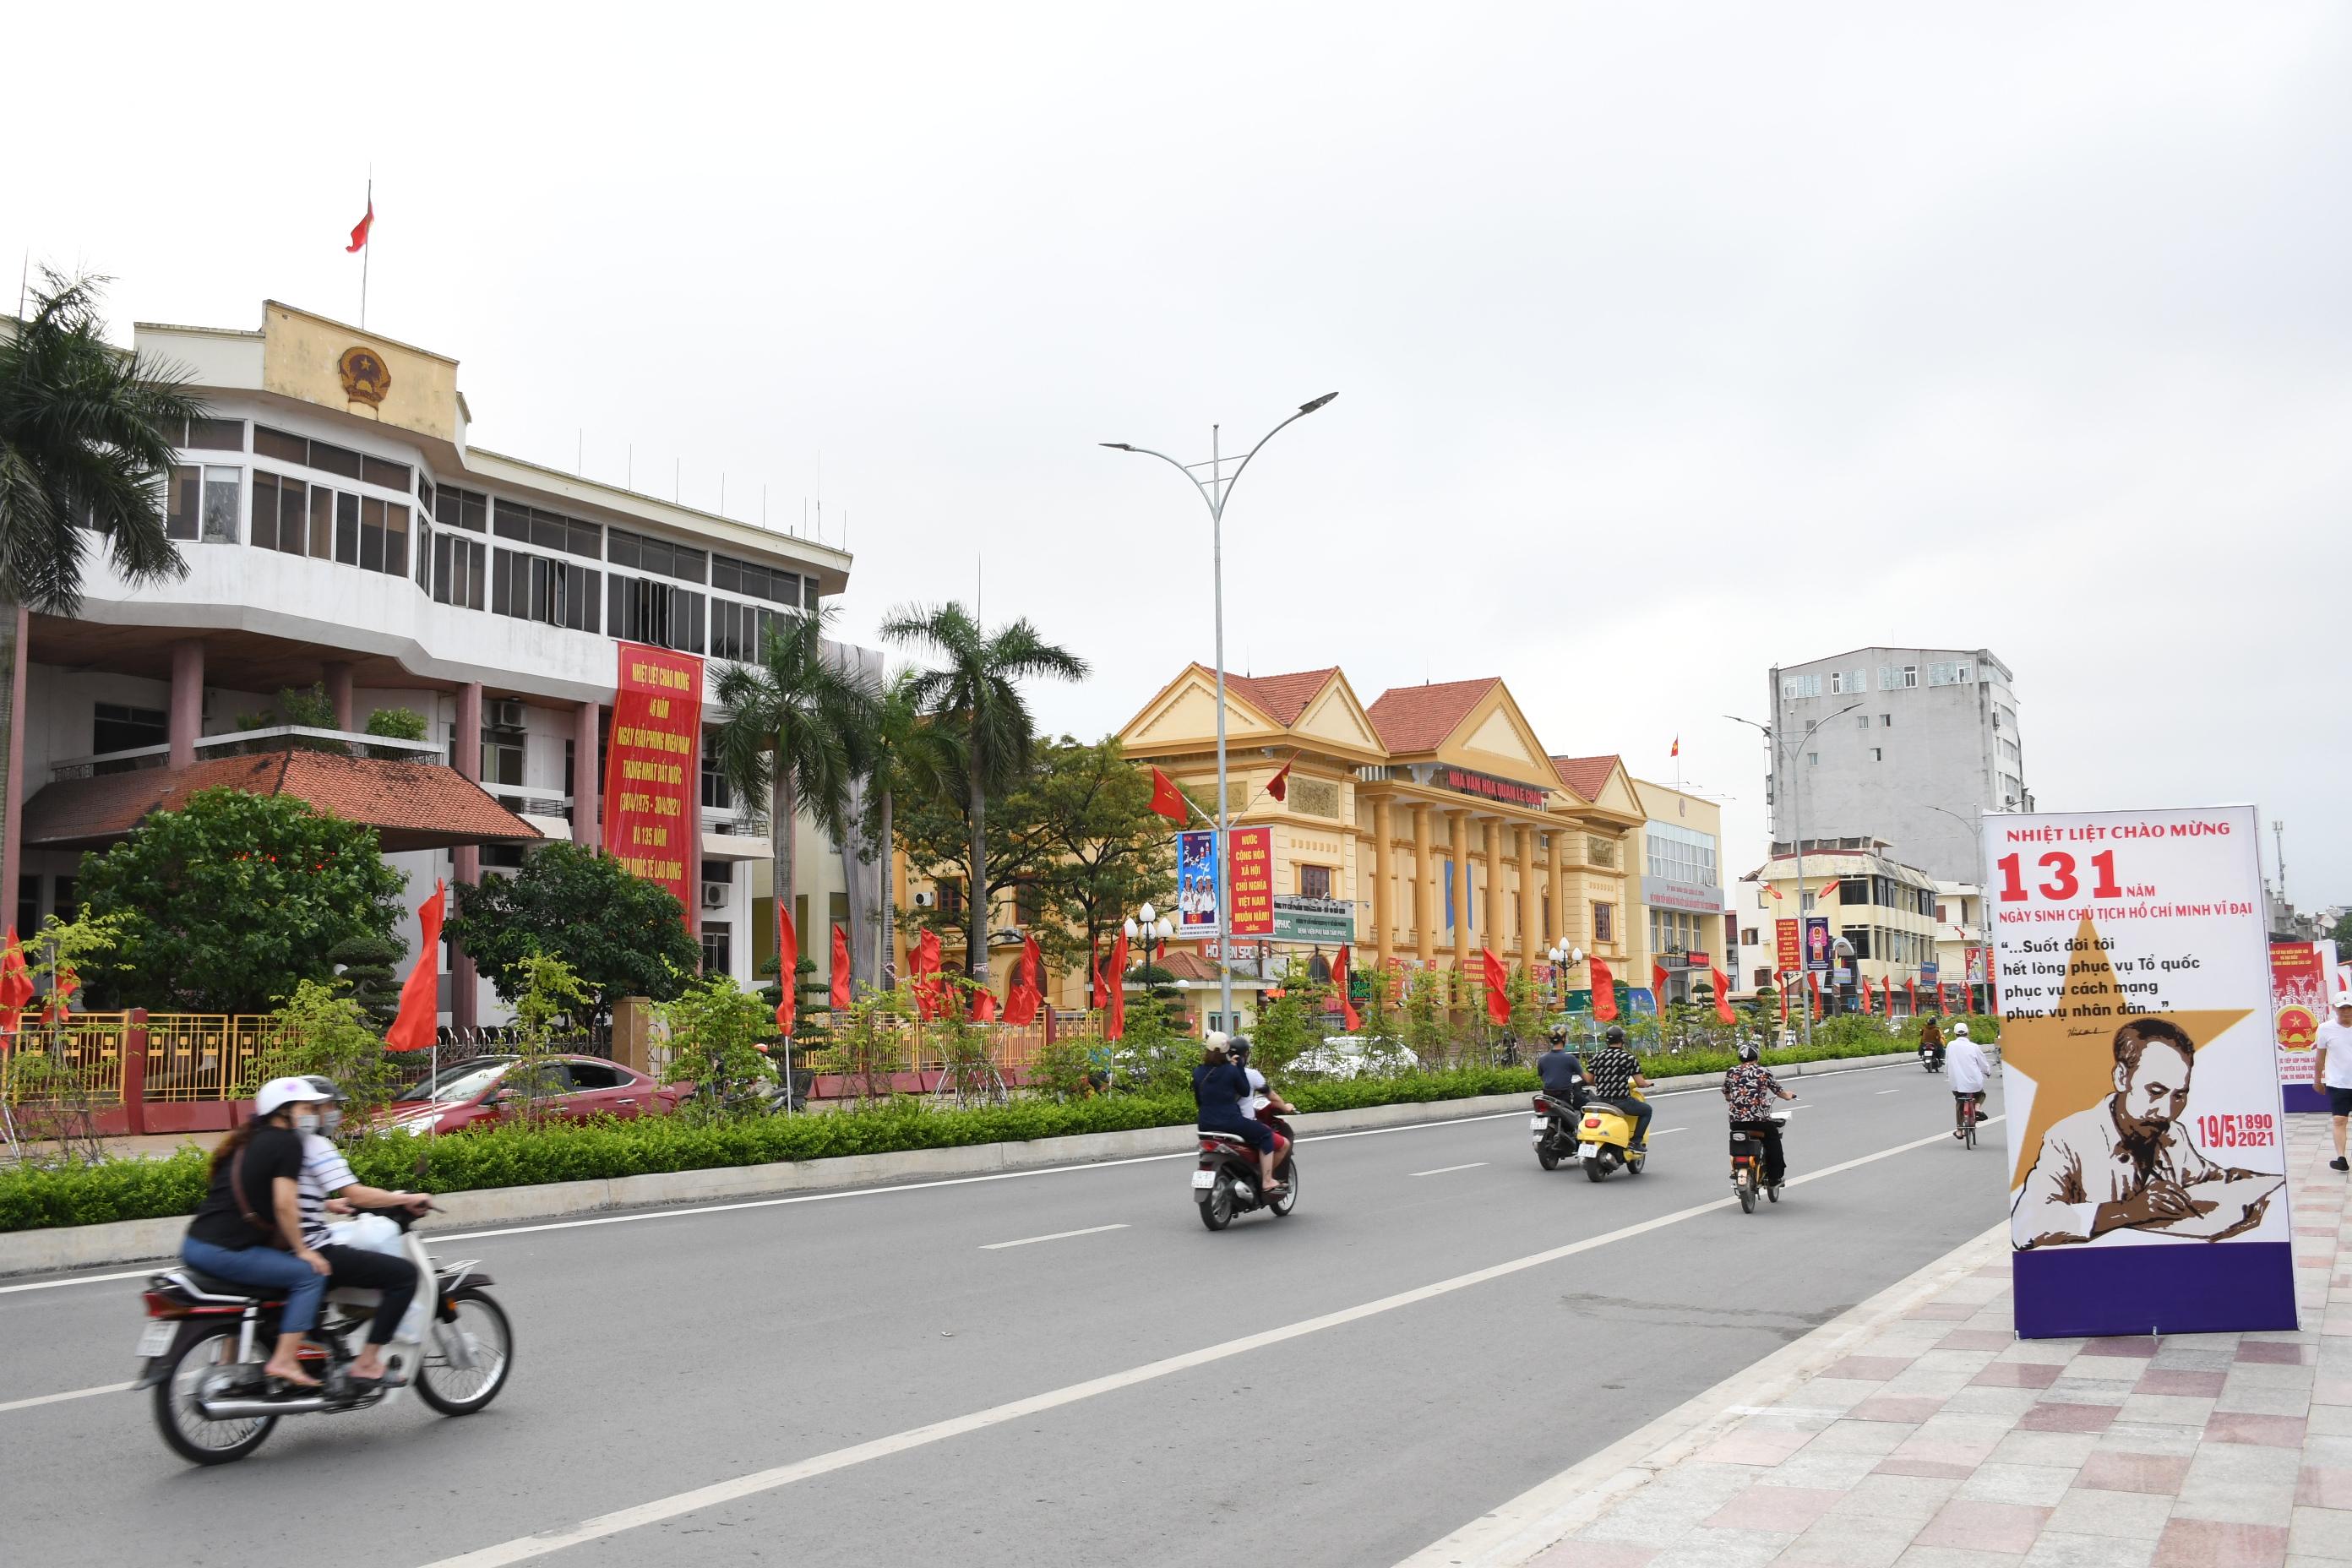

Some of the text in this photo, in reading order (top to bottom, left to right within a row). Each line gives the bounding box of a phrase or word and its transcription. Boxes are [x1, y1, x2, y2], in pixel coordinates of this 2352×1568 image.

[642, 827, 652, 846] 135
[2006, 820, 2230, 844] NHIỆT LIỆT CHÀO MỪNG
[617, 853, 630, 874] GÀY
[632, 852, 646, 877] QUỐC
[655, 861, 666, 879] LAO
[1236, 850, 1252, 863] CỘNG
[1250, 864, 1260, 877] HỘI
[1997, 849, 2155, 902] 131 NĂM
[1238, 896, 1266, 908] VIỆT NAM
[1999, 900, 2252, 923] NGÀY SINH CHỦ TỊCH HỒ CHÍ MINH VĨ ĐẠI
[2064, 938, 2088, 951] đời
[2093, 938, 2115, 950] tôi
[2003, 960, 2027, 976] hết
[2032, 961, 2066, 977] lòng
[2071, 960, 2110, 976] phục
[2115, 961, 2133, 975] vụ
[2137, 954, 2155, 970] Tổ
[2160, 953, 2200, 972] quốc
[2005, 982, 2158, 1000] phục vụ cách mạng
[2006, 1007, 2044, 1022] phục
[2049, 1008, 2067, 1021] vụ
[2072, 1004, 2111, 1017] nhân
[2197, 1114, 2273, 1147] 19/5 1890
[2238, 1131, 2273, 1146] 2021
